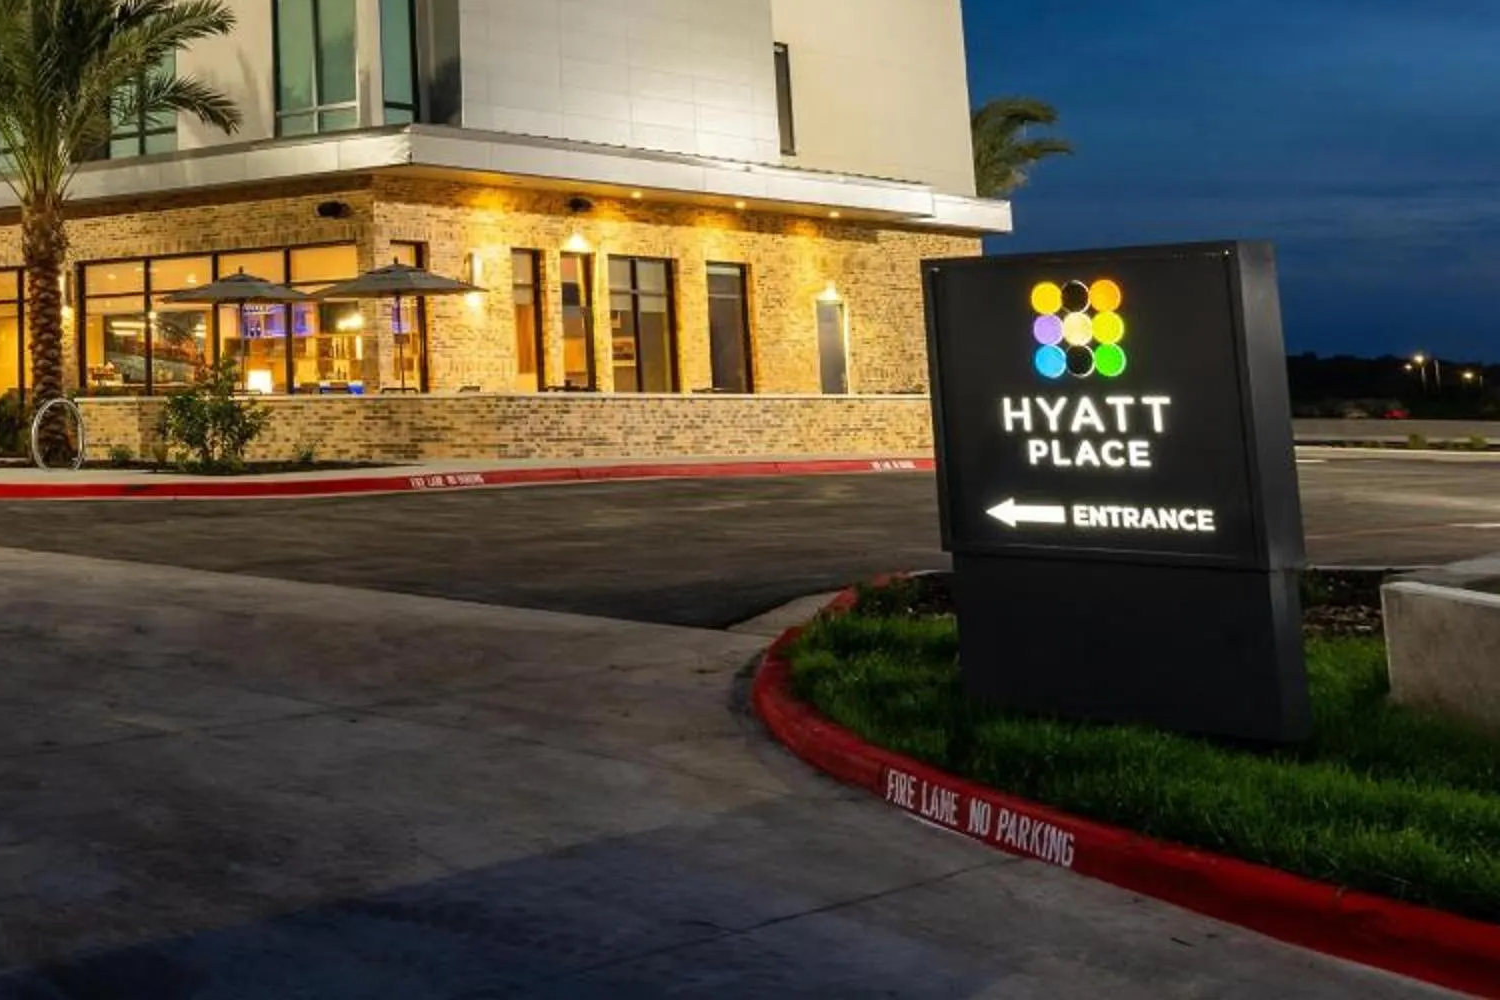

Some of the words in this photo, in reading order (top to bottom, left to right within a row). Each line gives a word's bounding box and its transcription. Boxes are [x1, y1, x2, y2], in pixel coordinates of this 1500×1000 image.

[1002, 396, 1171, 433] HYATT
[1028, 439, 1152, 467] PLACE
[1073, 505, 1215, 532] ENTRANCE
[885, 769, 917, 810] FIRE
[920, 780, 960, 825] LANE
[967, 798, 991, 837] NO
[996, 808, 1075, 867] PARKING
